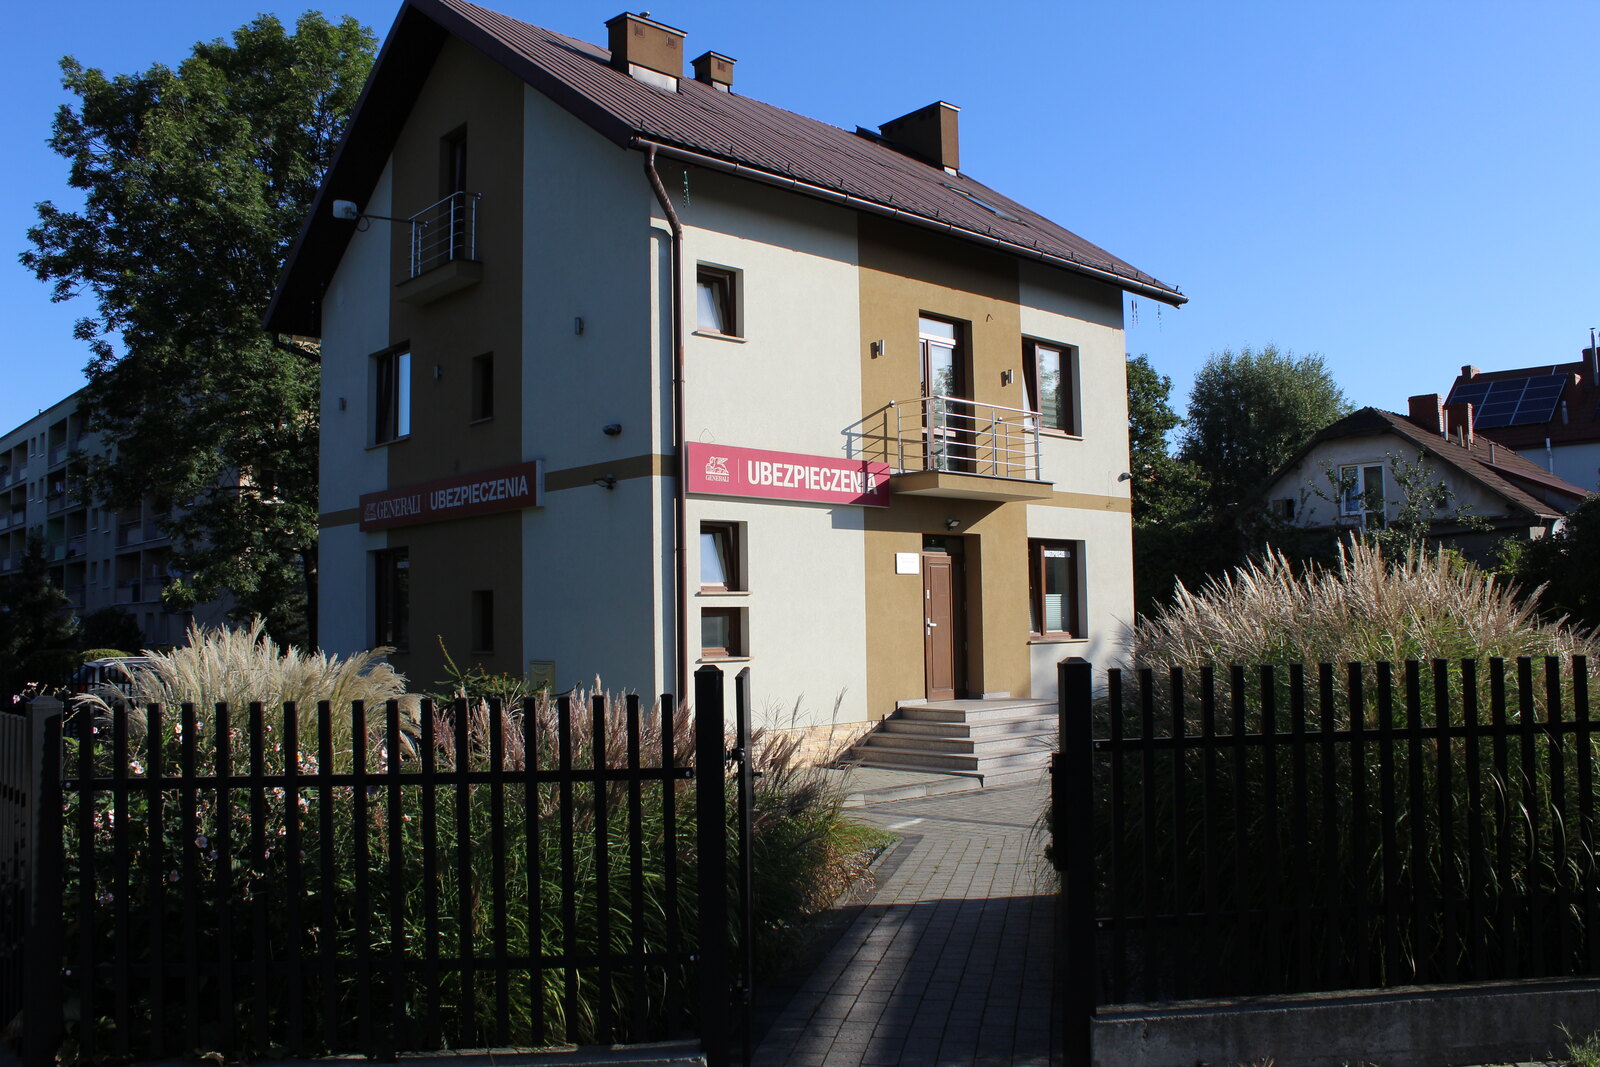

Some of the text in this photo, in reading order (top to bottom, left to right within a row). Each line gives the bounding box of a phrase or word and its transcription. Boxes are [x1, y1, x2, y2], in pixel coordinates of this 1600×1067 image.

[705, 474, 730, 483] GENERALI
[747, 460, 878, 495] UBEZPIECZENIA
[376, 475, 529, 519] GENERALI UBEZPIECZENIA
